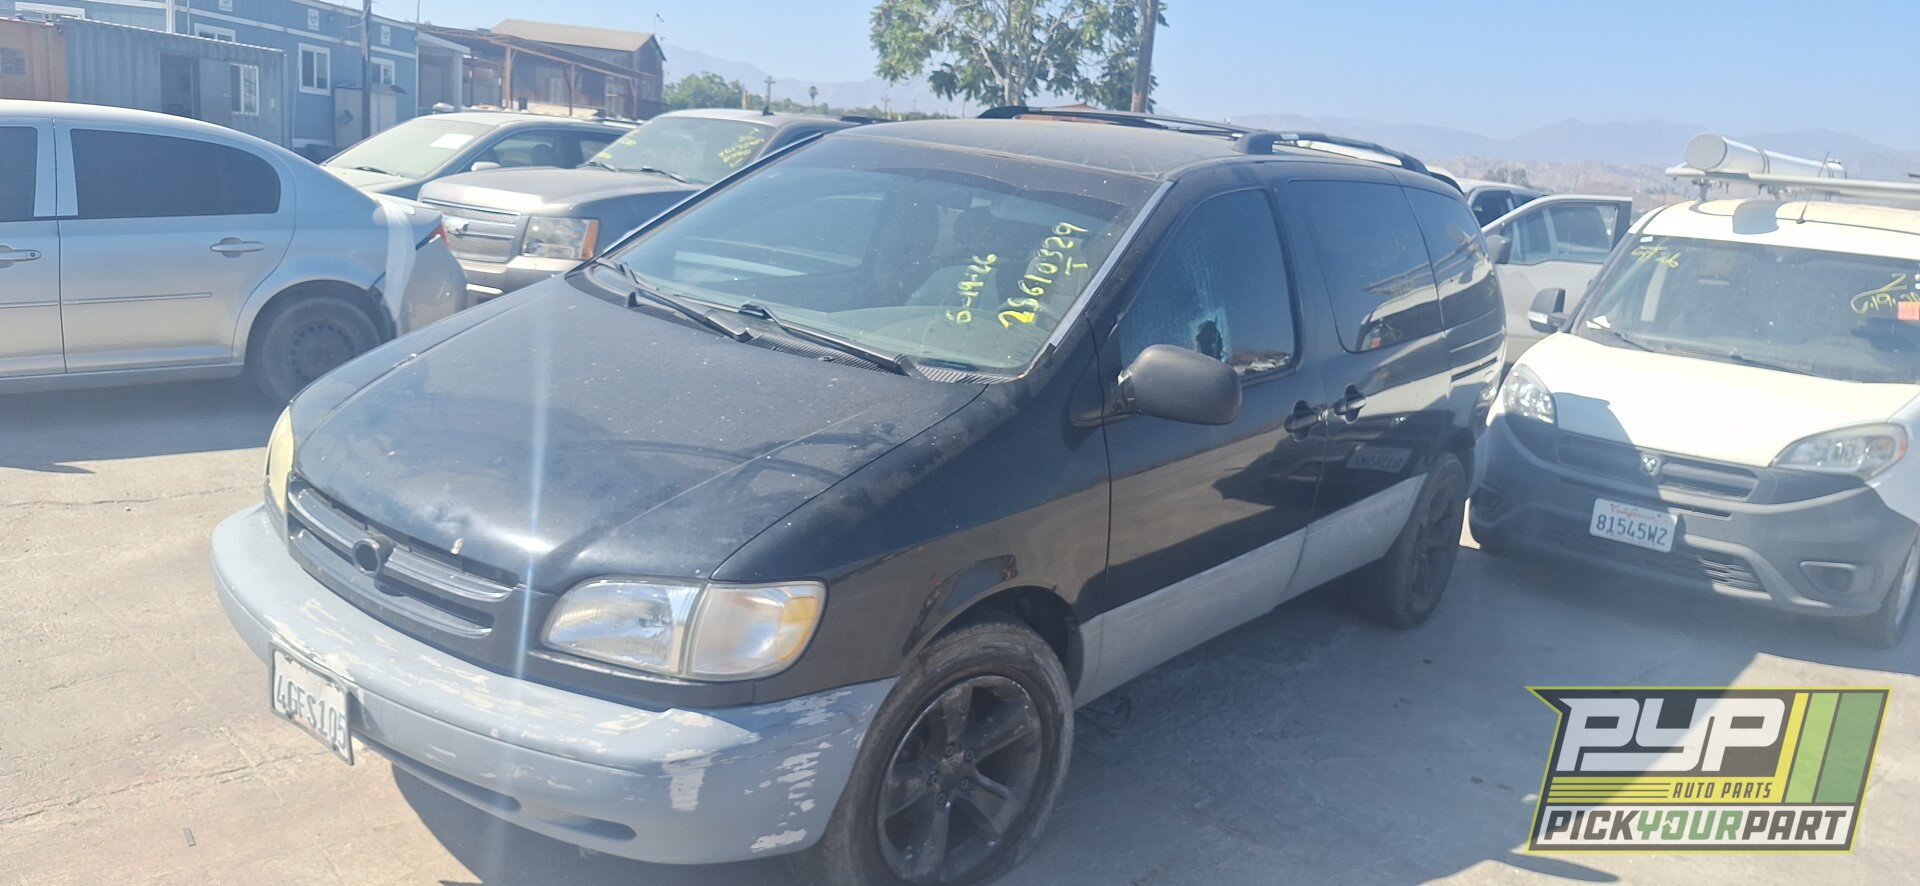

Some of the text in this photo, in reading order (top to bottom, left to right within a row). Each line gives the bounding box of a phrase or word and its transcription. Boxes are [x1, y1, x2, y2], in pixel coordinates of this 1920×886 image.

[998, 222, 1089, 328] 25610329
[1596, 514, 1668, 546] 81545W2
[277, 674, 347, 749] 4GFS105
